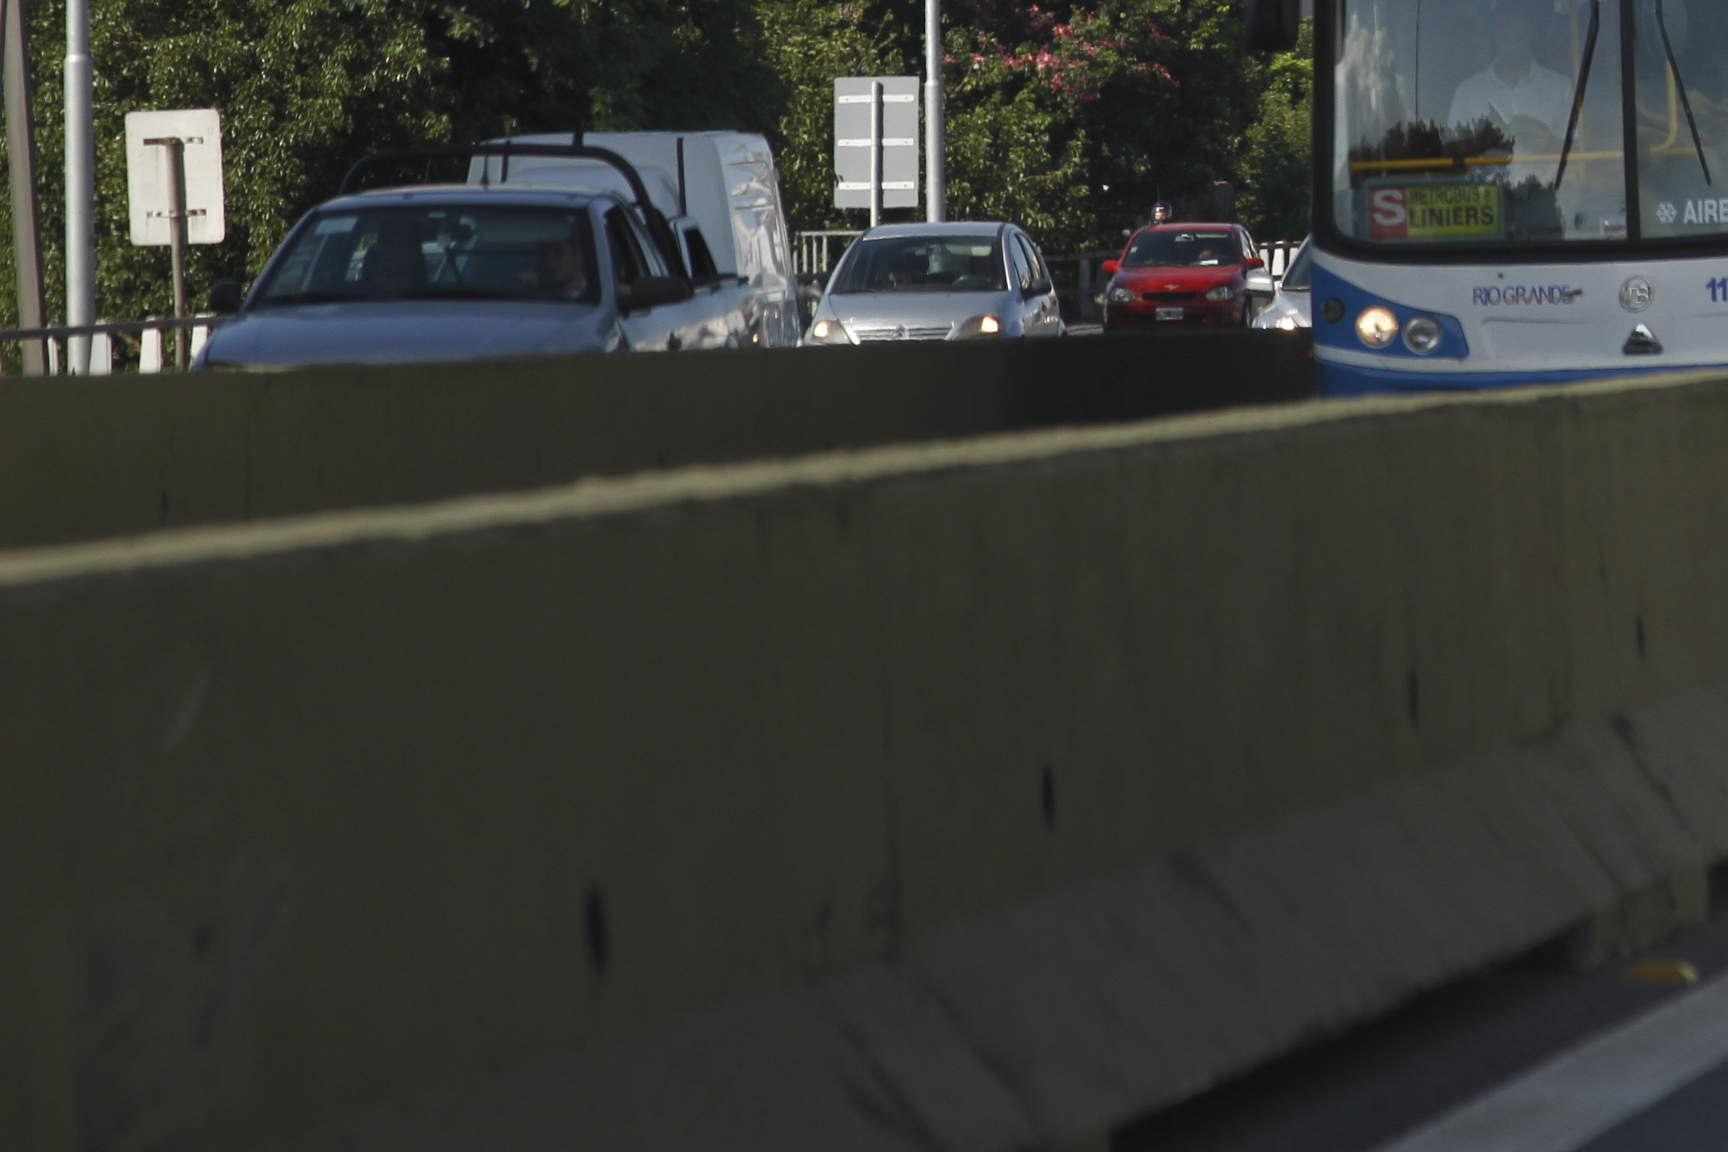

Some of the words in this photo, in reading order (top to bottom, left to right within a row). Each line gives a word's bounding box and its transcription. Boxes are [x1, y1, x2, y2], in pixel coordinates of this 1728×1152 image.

[1372, 188, 1406, 227] S
[1409, 187, 1480, 206] METROBUS
[1409, 205, 1495, 228] LINIERS
